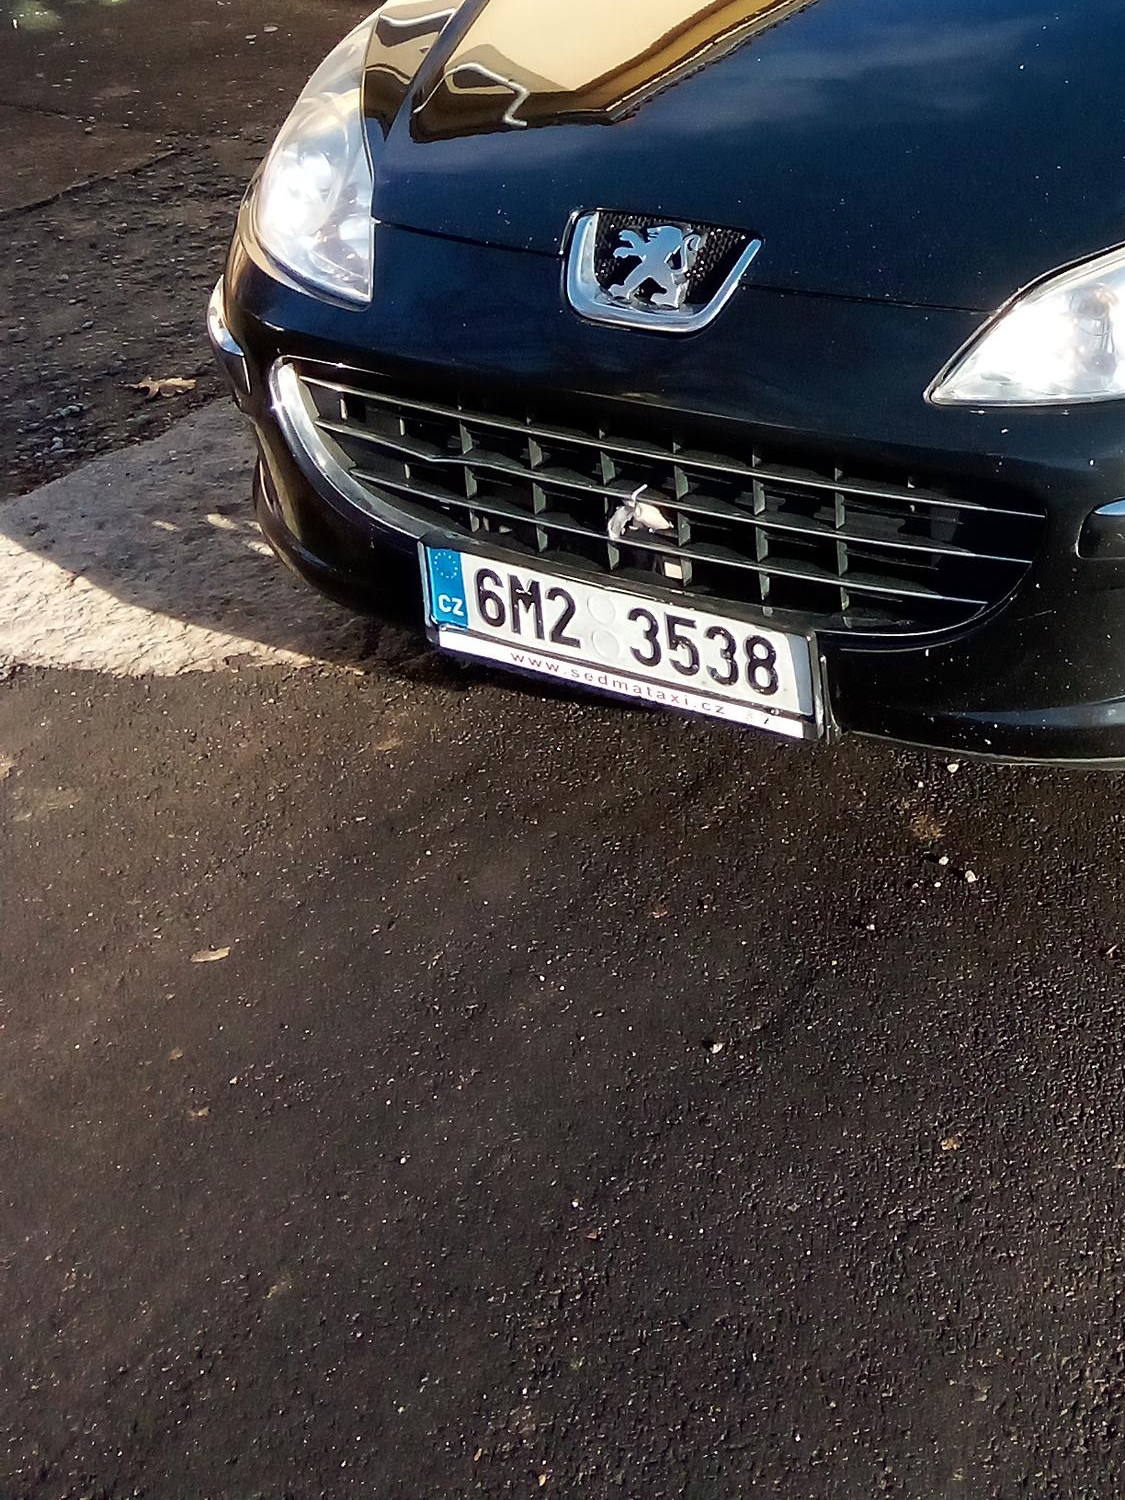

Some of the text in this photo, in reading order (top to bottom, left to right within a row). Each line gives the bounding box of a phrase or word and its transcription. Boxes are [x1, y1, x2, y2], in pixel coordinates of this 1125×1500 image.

[438, 594, 464, 617] CZ
[475, 568, 780, 696] 6M2 3538
[511, 650, 726, 716] www.sedmataxi.cz
